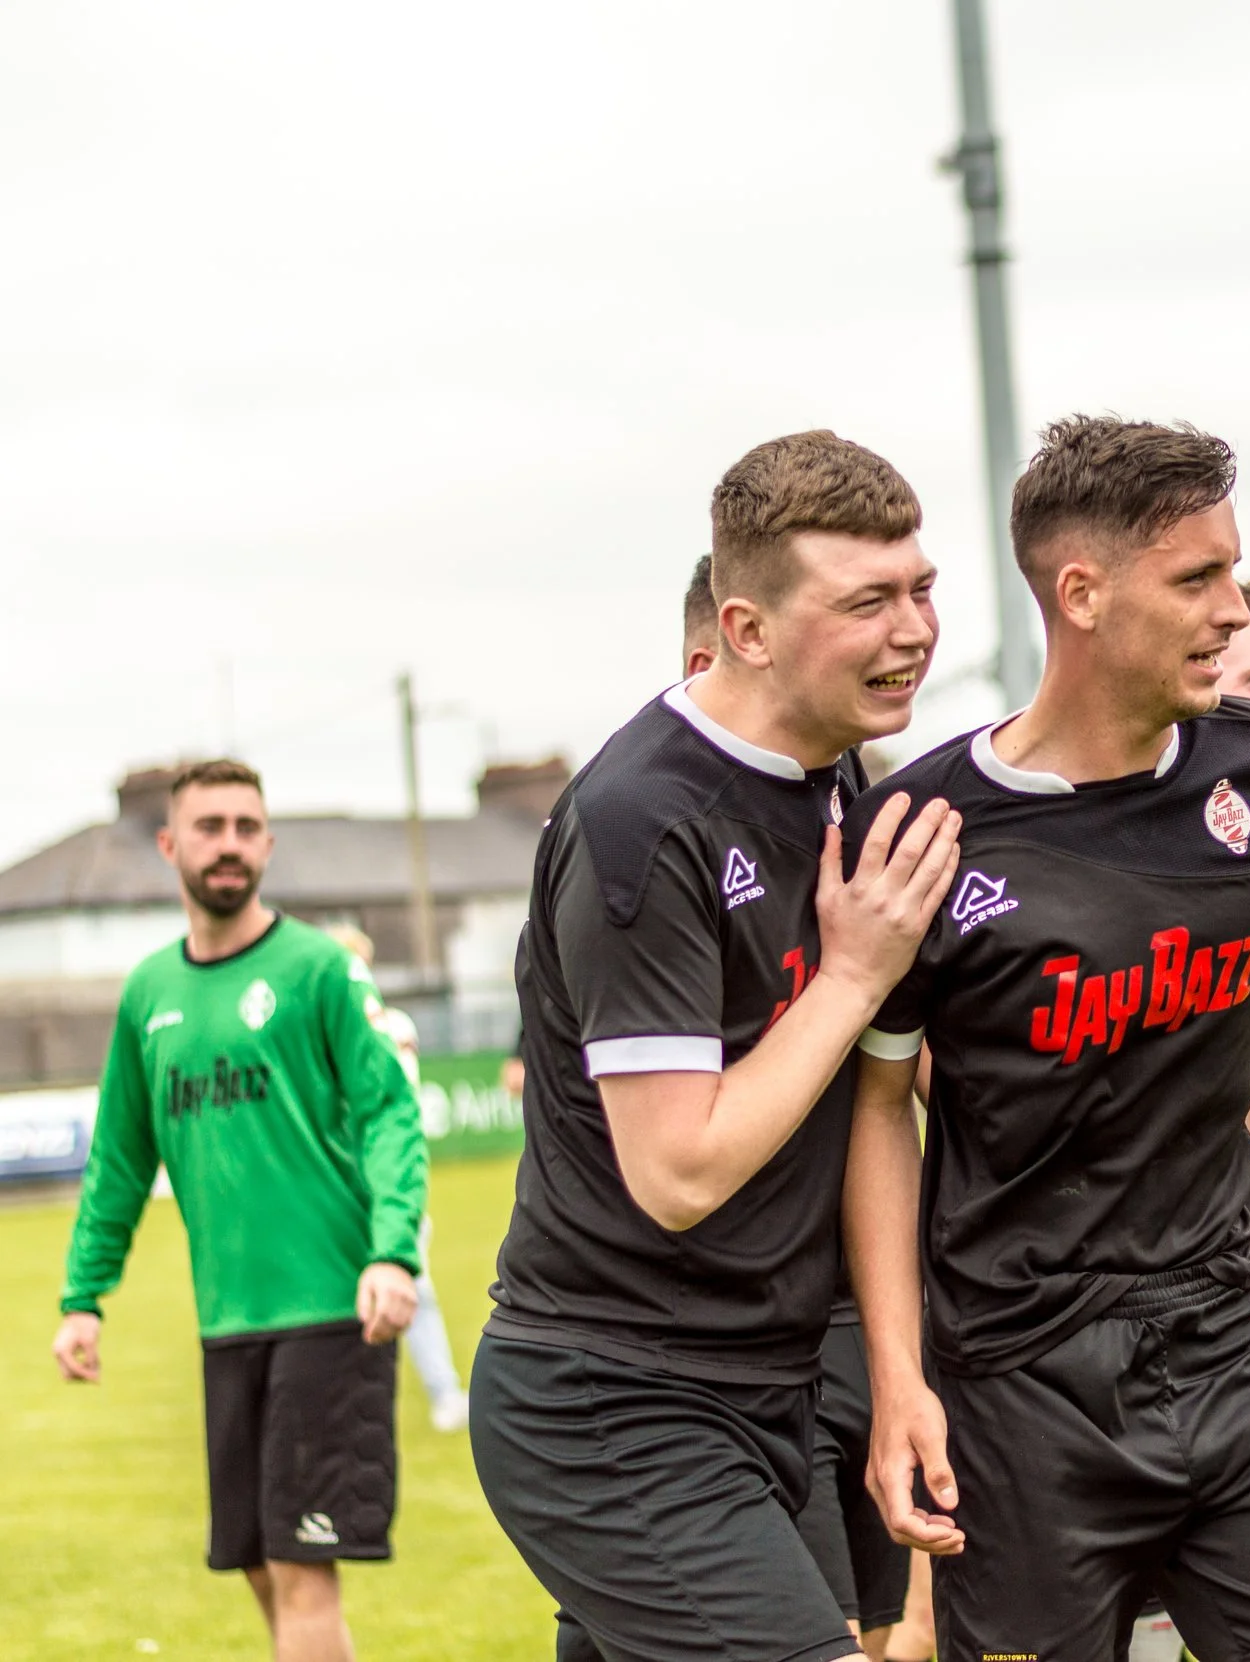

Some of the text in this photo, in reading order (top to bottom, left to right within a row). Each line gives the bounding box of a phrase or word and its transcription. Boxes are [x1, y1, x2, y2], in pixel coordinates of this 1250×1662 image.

[1212, 807, 1244, 828] JAY BAZZ
[1030, 954, 1143, 1065] JAY
